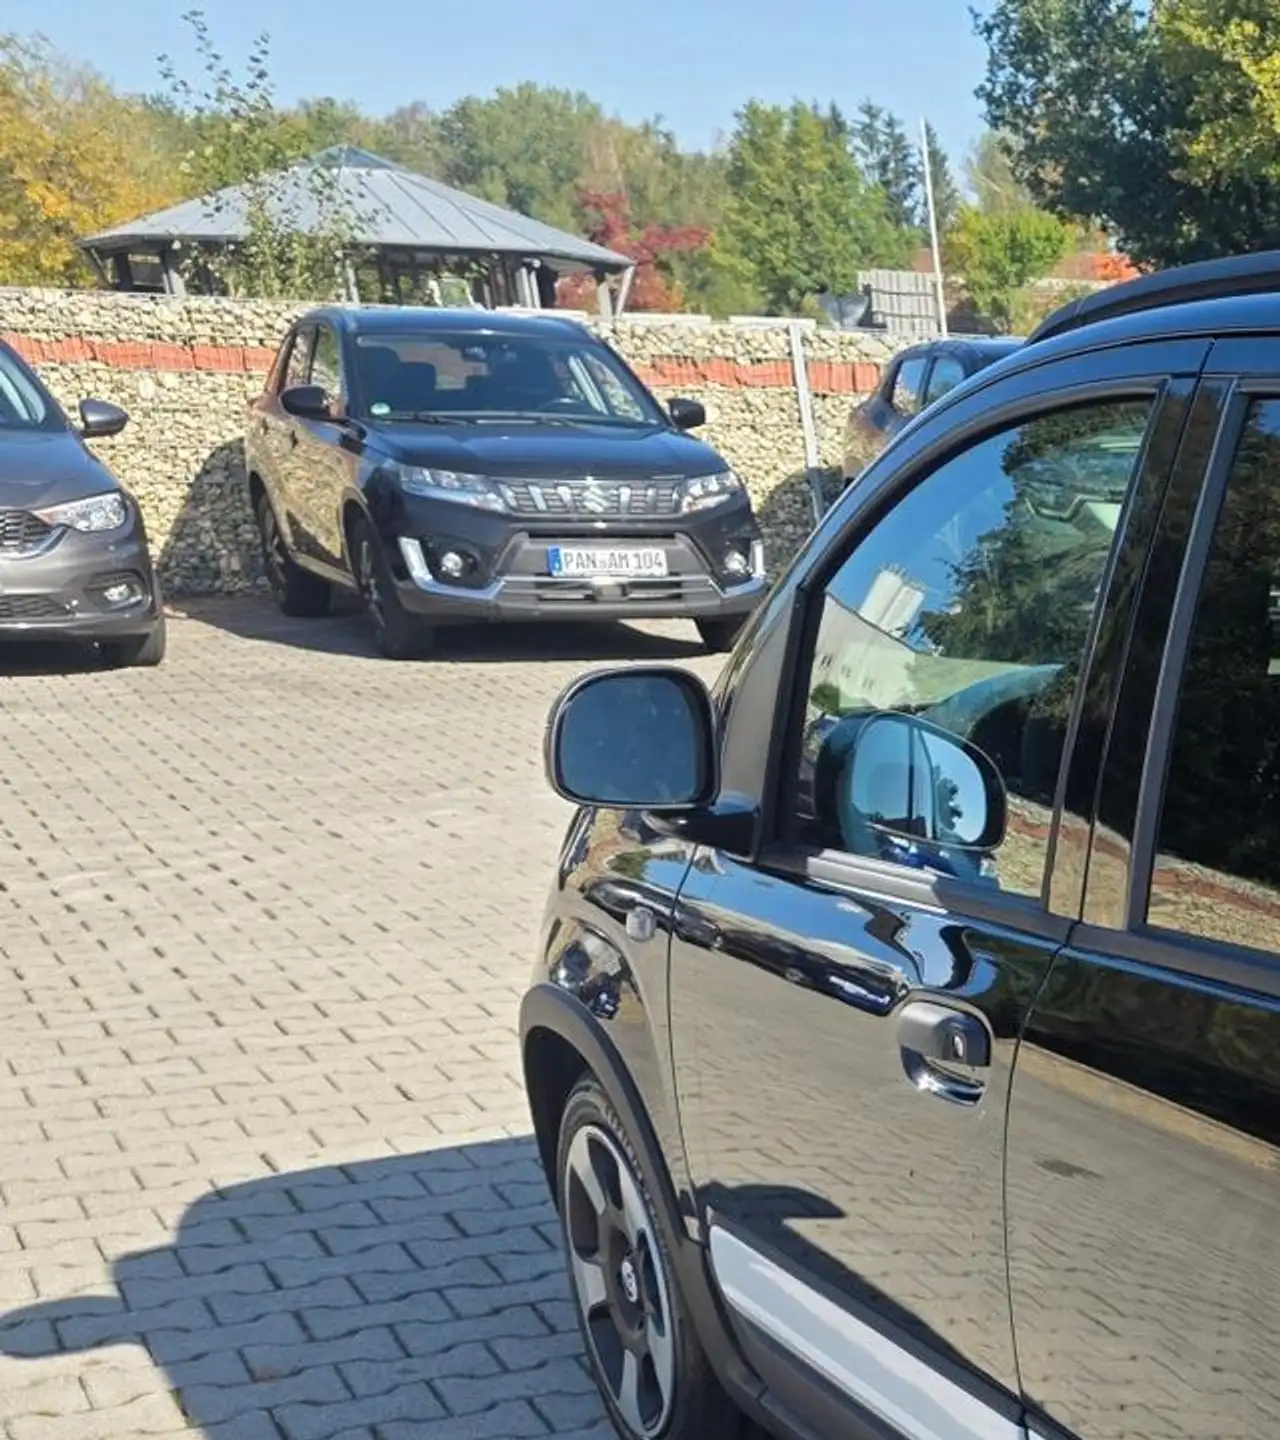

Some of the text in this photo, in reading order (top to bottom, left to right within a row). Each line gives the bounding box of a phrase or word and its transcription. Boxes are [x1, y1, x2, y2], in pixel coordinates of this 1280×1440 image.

[564, 551, 664, 570] PAN AM 104
